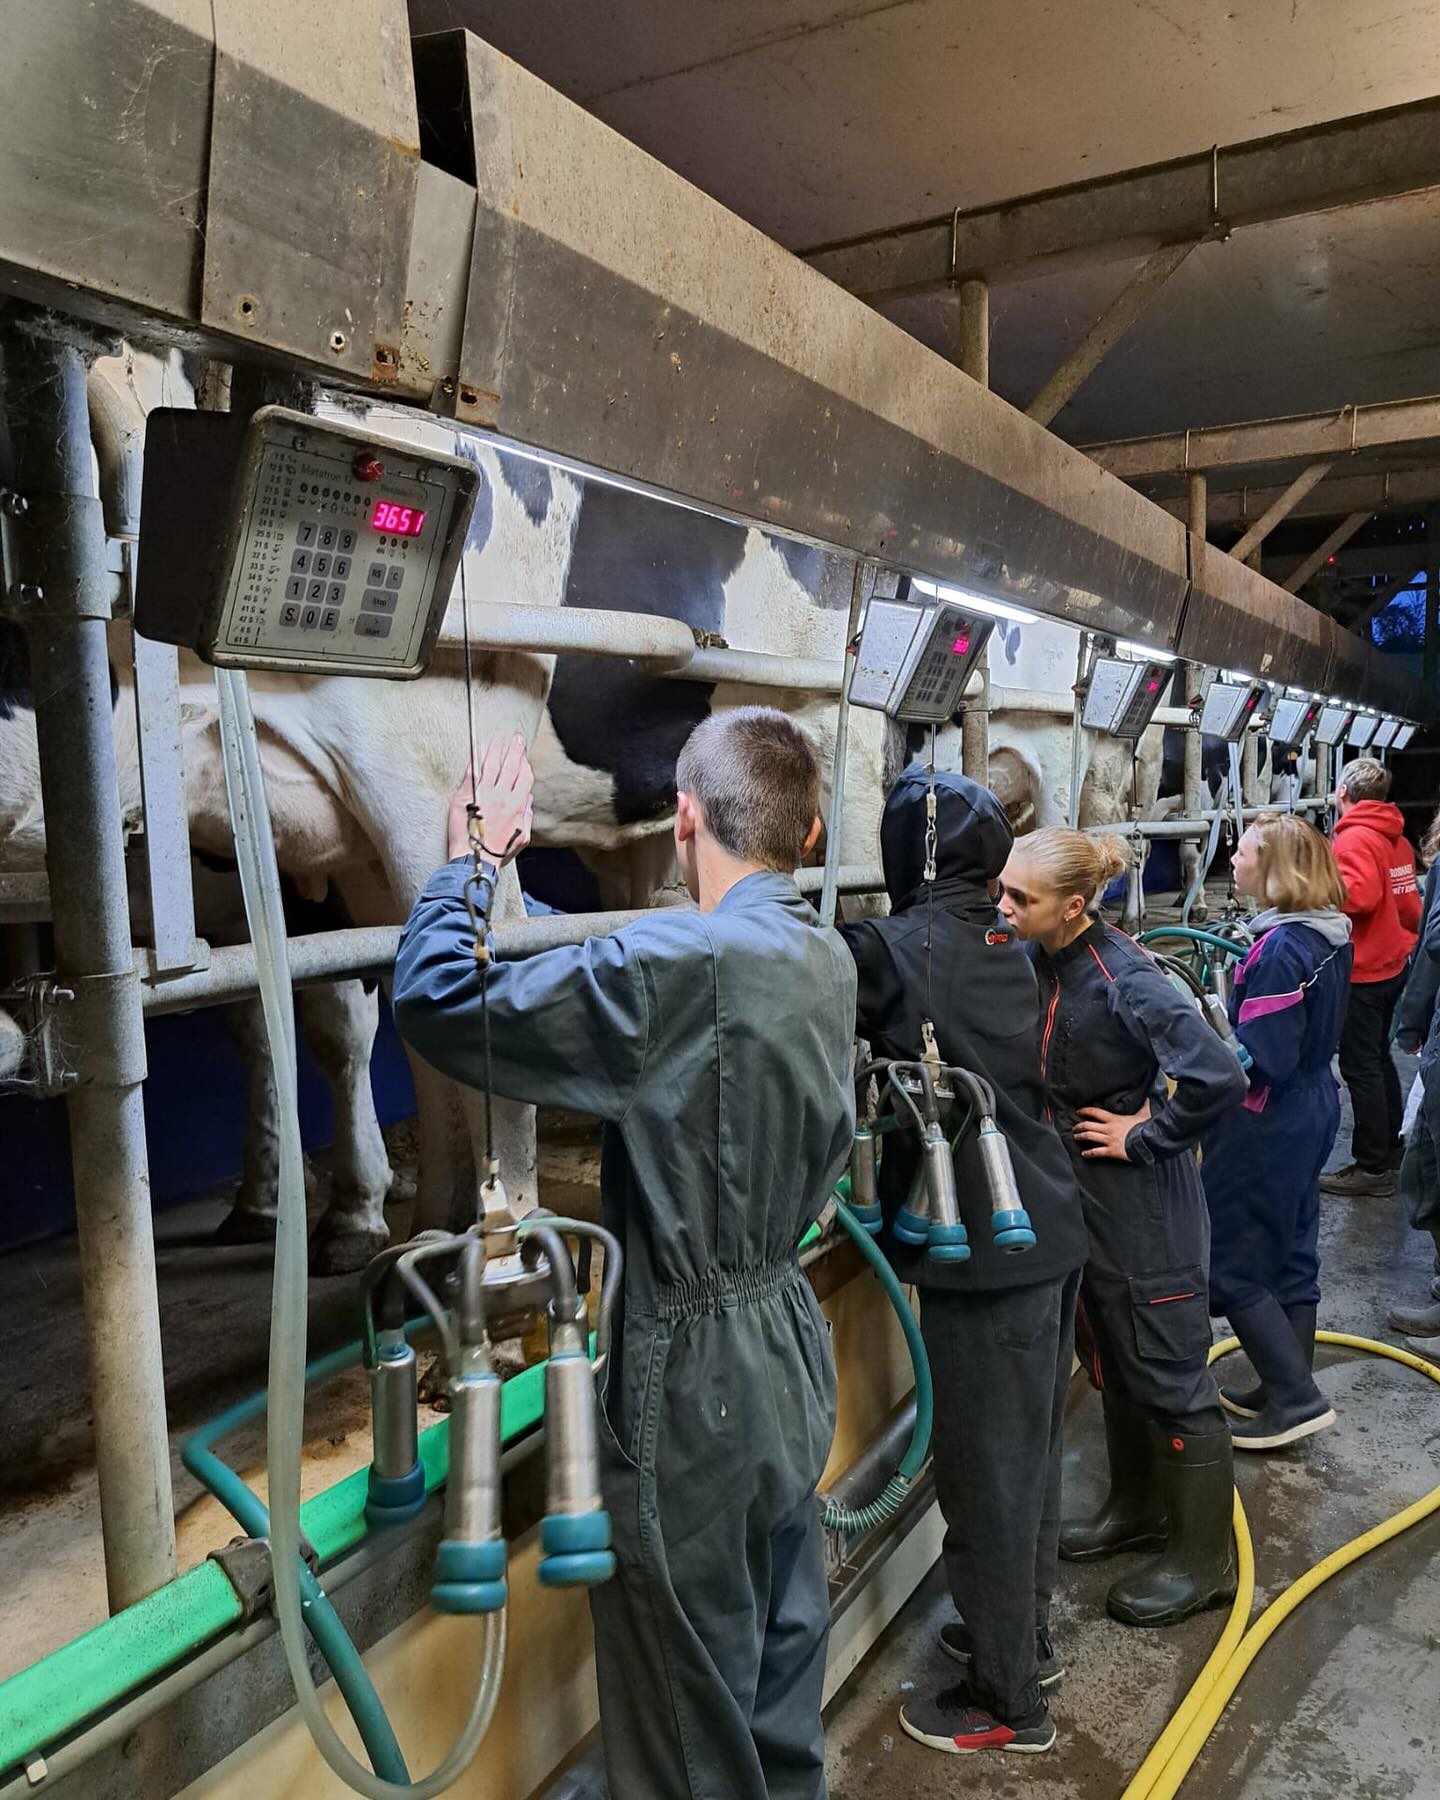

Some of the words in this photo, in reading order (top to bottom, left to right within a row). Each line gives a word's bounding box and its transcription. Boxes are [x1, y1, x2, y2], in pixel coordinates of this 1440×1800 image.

[373, 503, 424, 533] 3651
[303, 527, 311, 541] 7
[323, 531, 332, 545] 8
[343, 535, 352, 549] 9
[297, 555, 306, 568] 4
[318, 558, 326, 572] 5
[338, 561, 346, 576] 6
[293, 581, 299, 595] 1
[311, 584, 320, 599] 2
[331, 587, 340, 601] 3
[284, 607, 295, 622] S
[306, 610, 315, 624] 0
[325, 612, 335, 626] E
